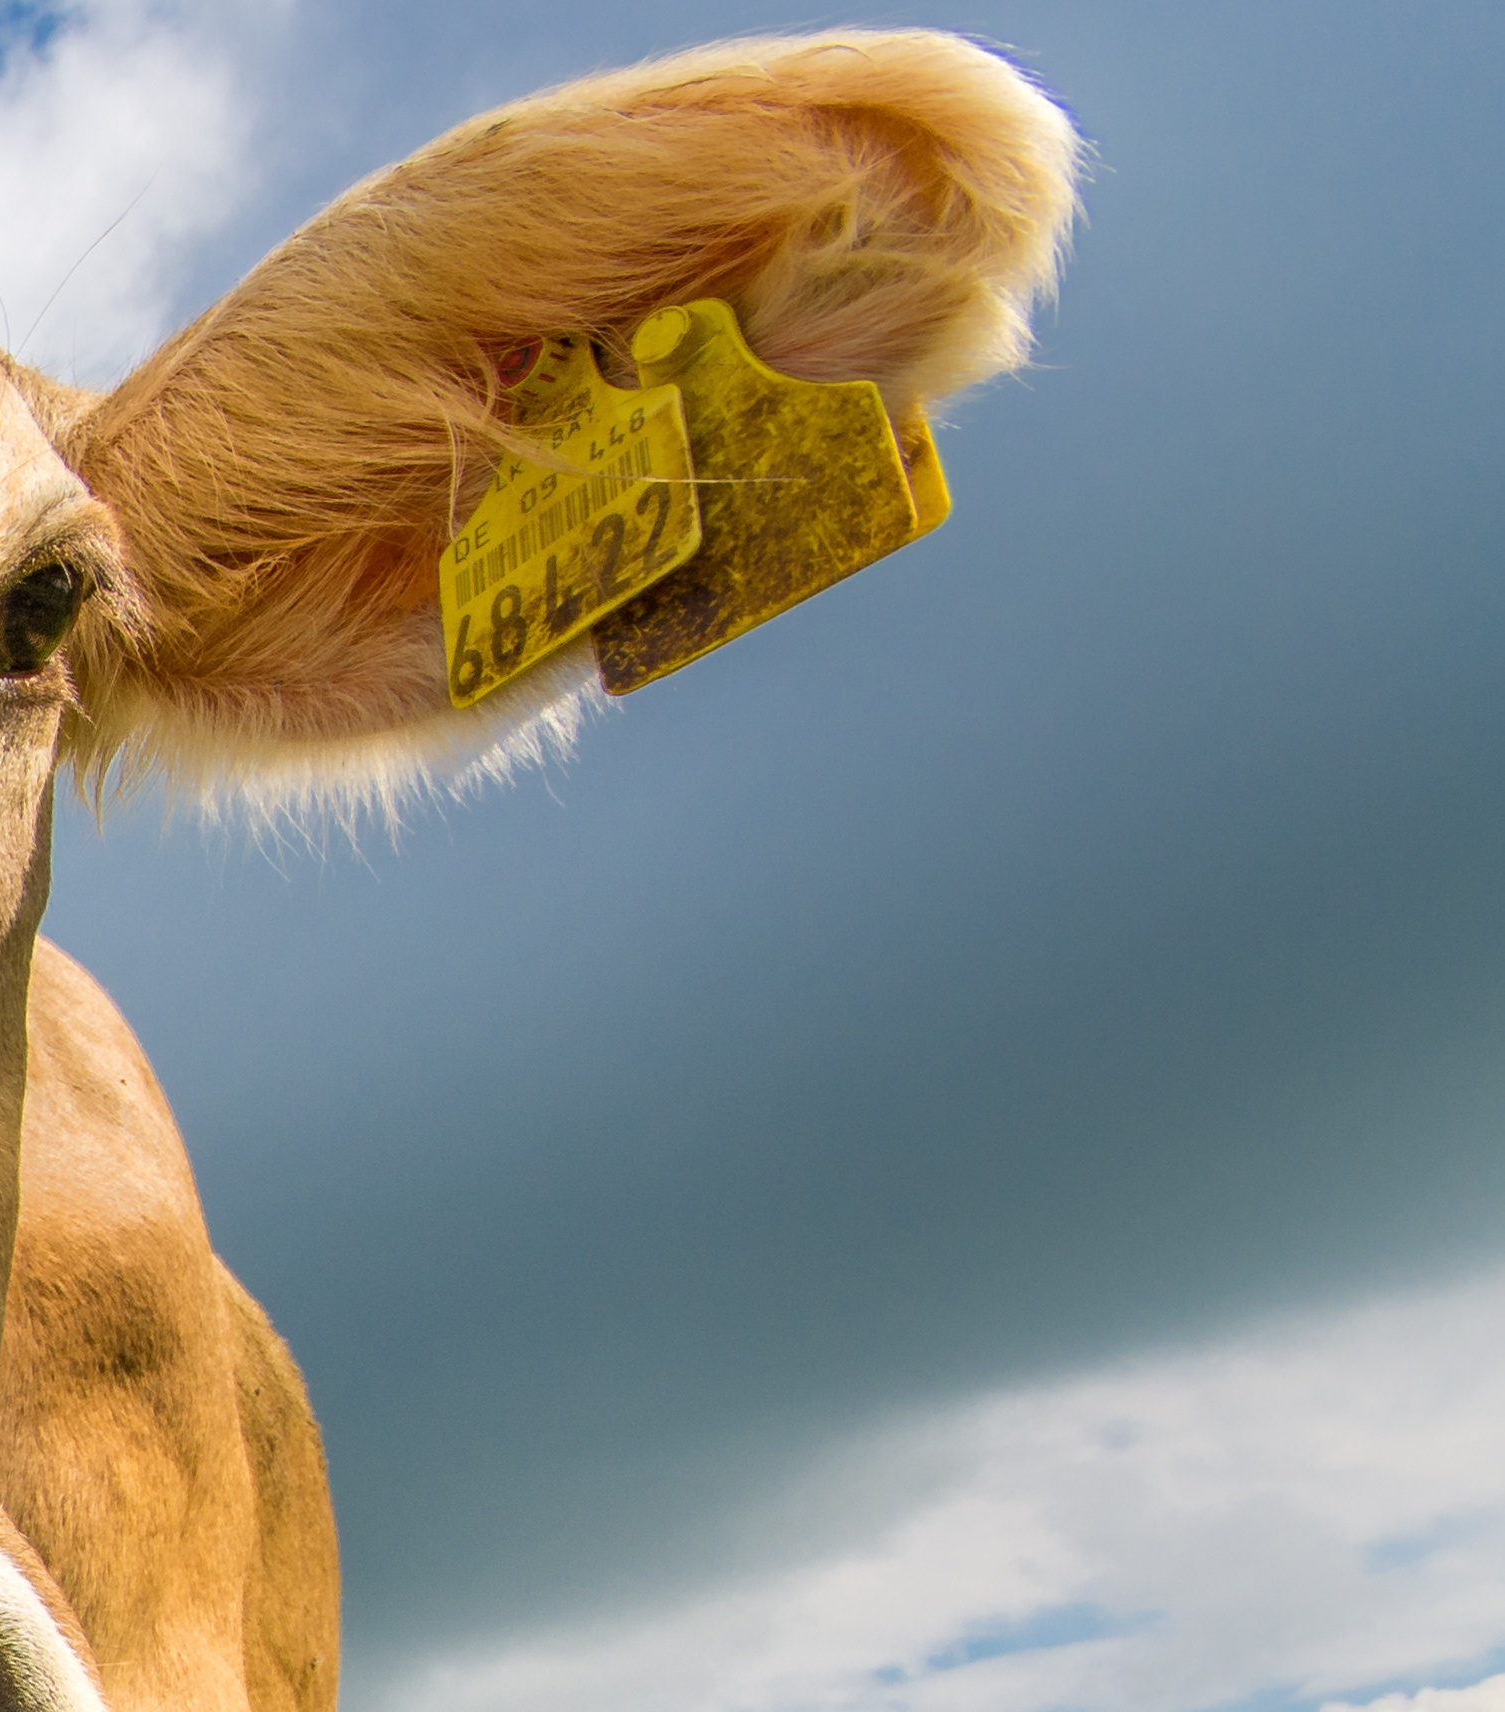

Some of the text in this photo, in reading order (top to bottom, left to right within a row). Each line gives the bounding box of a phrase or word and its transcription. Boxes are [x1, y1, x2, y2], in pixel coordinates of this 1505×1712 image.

[455, 408, 645, 564] DE 09 448
[450, 481, 679, 697] 68422
